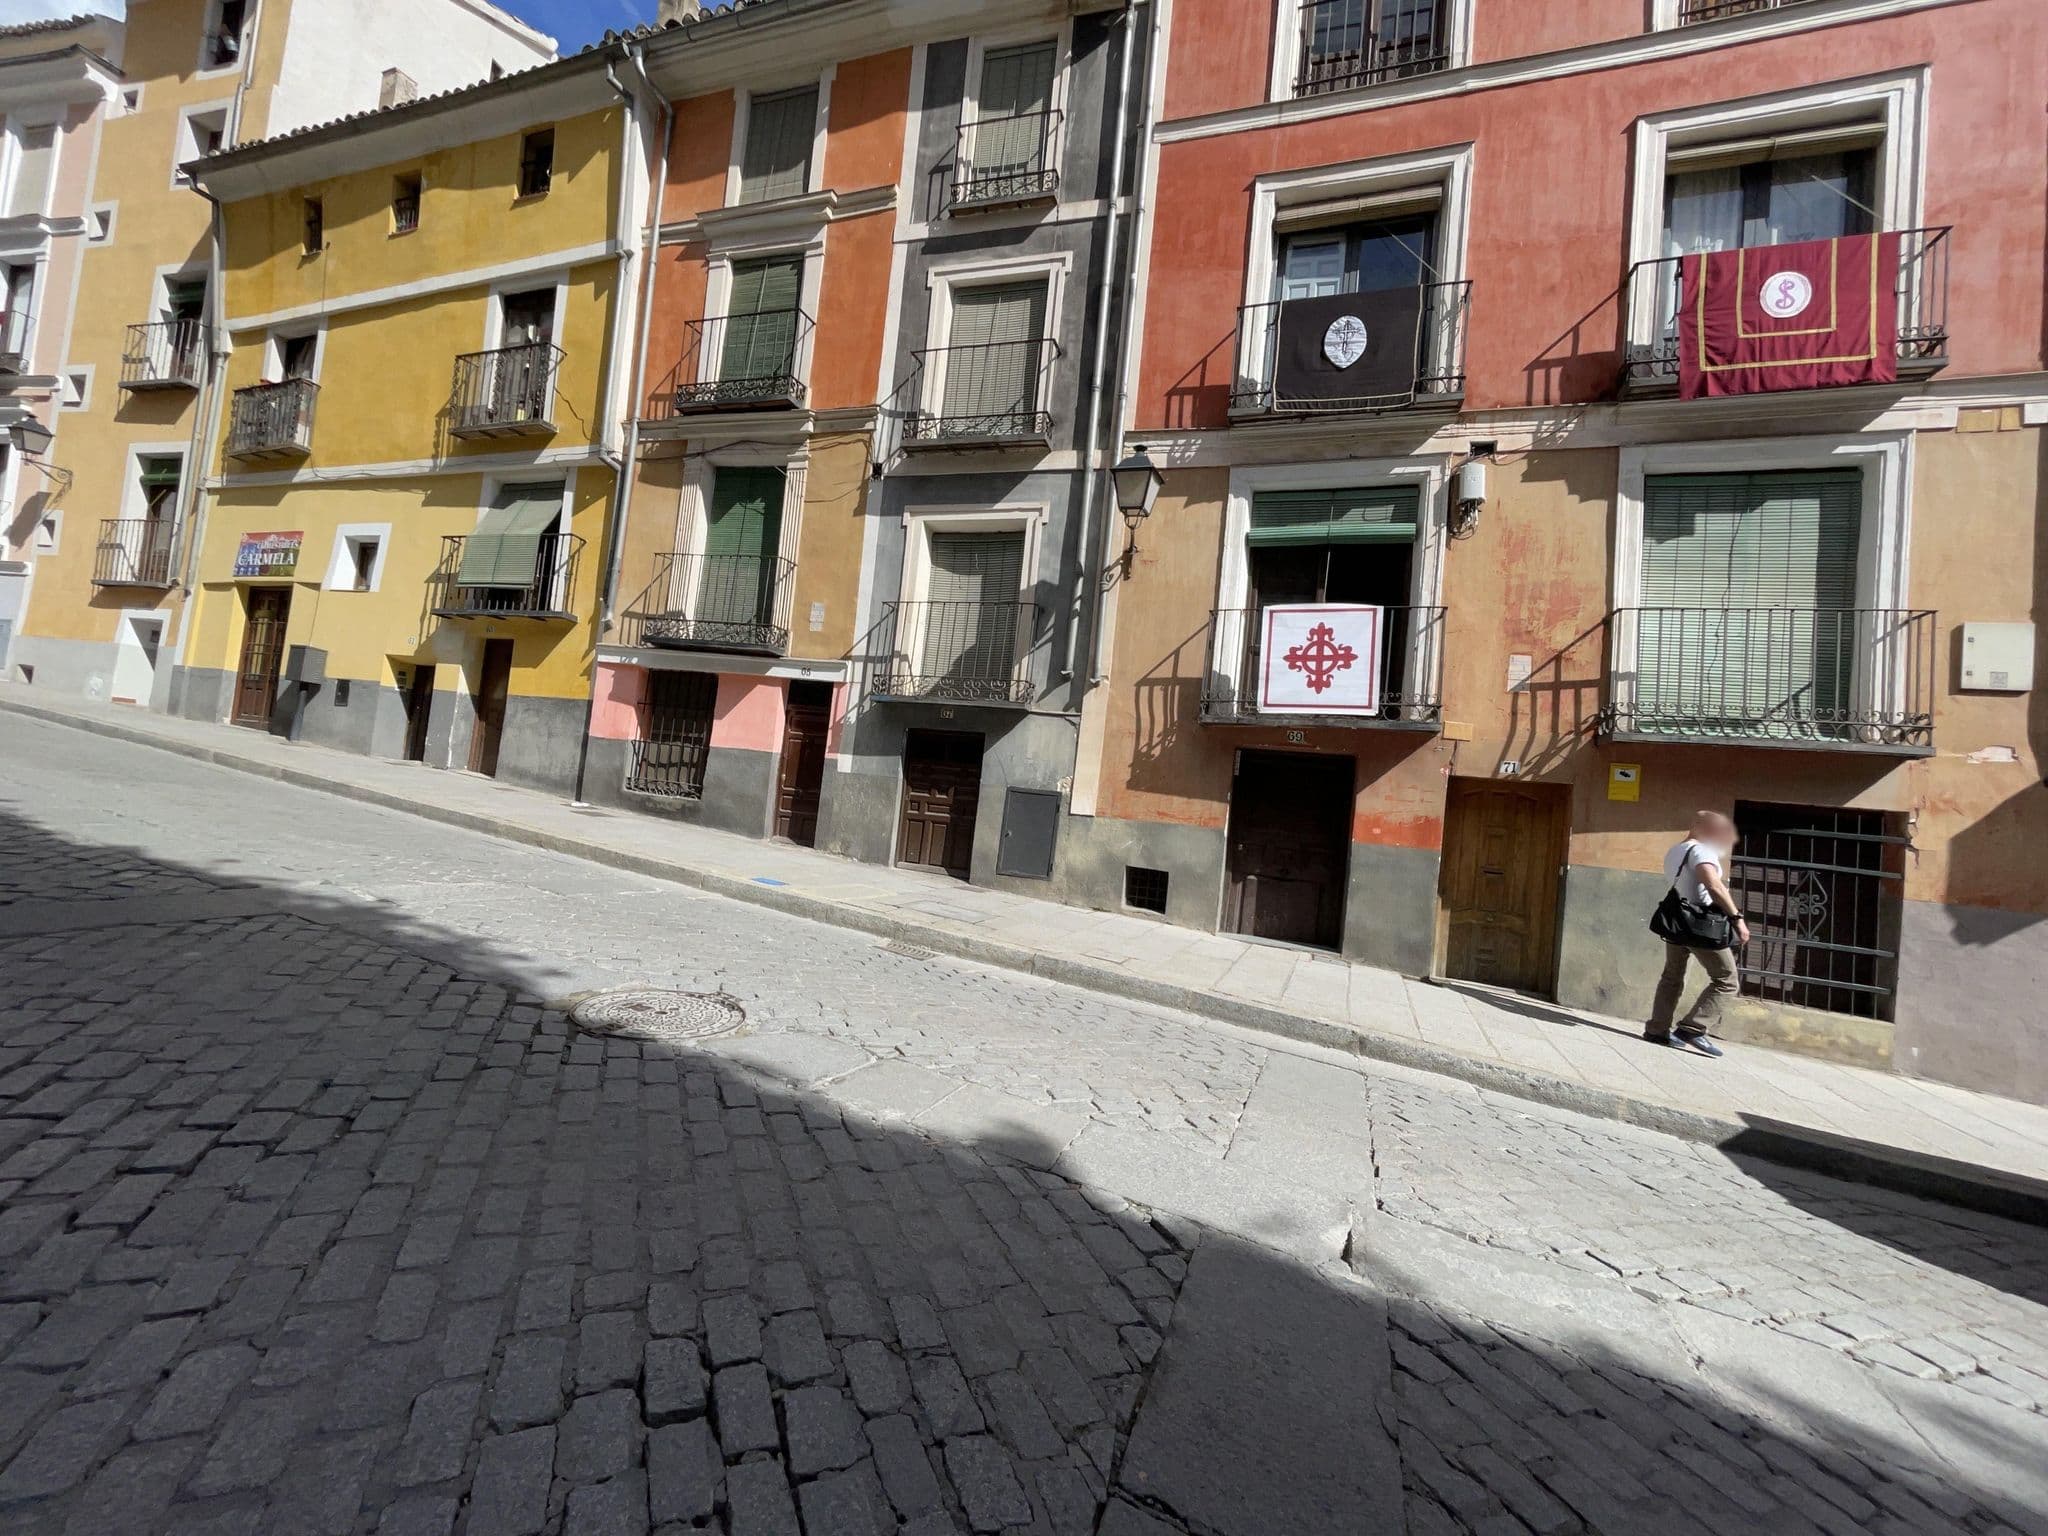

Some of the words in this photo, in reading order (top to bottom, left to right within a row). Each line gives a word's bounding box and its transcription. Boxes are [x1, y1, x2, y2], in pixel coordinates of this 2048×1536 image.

[238, 552, 295, 566] CARMELA
[1288, 731, 1303, 742] 69
[1503, 762, 1517, 773] 71
